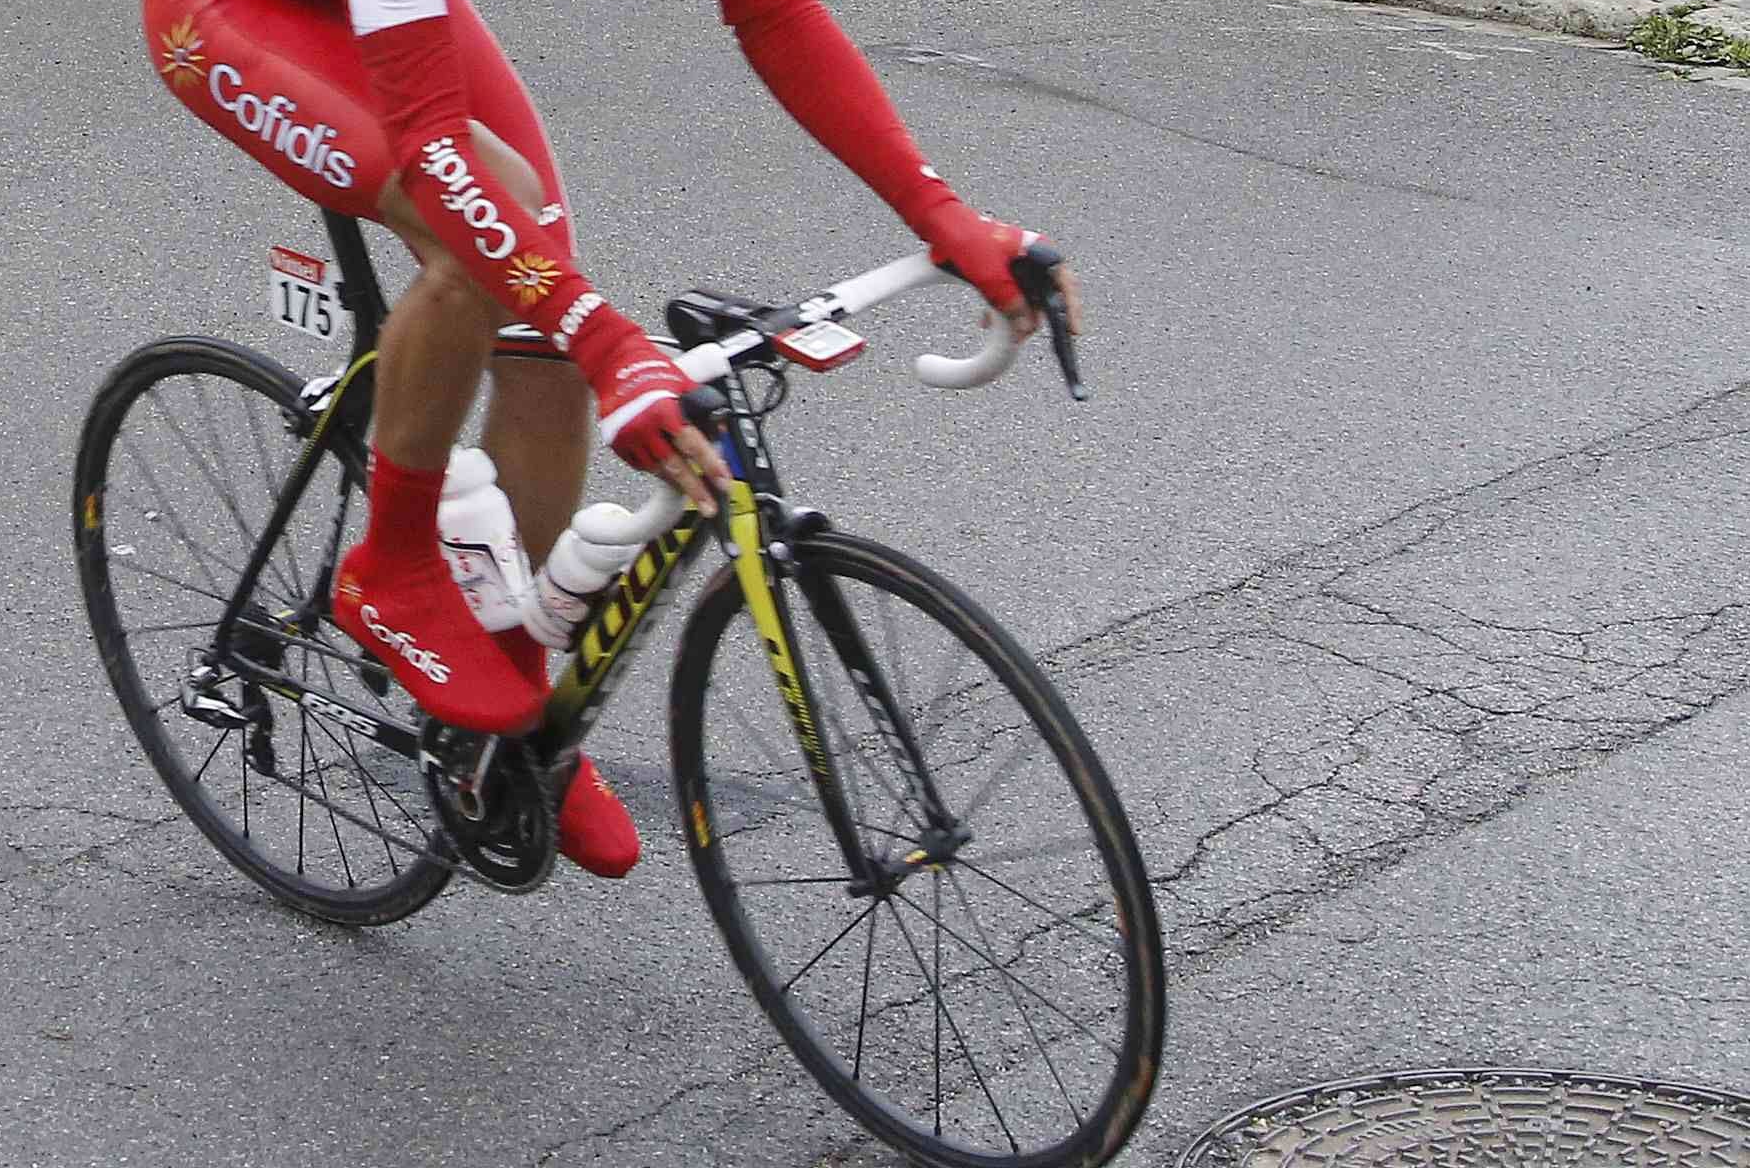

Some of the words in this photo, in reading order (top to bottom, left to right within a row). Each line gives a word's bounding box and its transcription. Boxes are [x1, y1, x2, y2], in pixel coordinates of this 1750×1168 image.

[208, 63, 357, 189] Cofidis
[419, 136, 517, 260] Cofidis
[281, 281, 332, 336] 175
[360, 604, 452, 684] Cofidis
